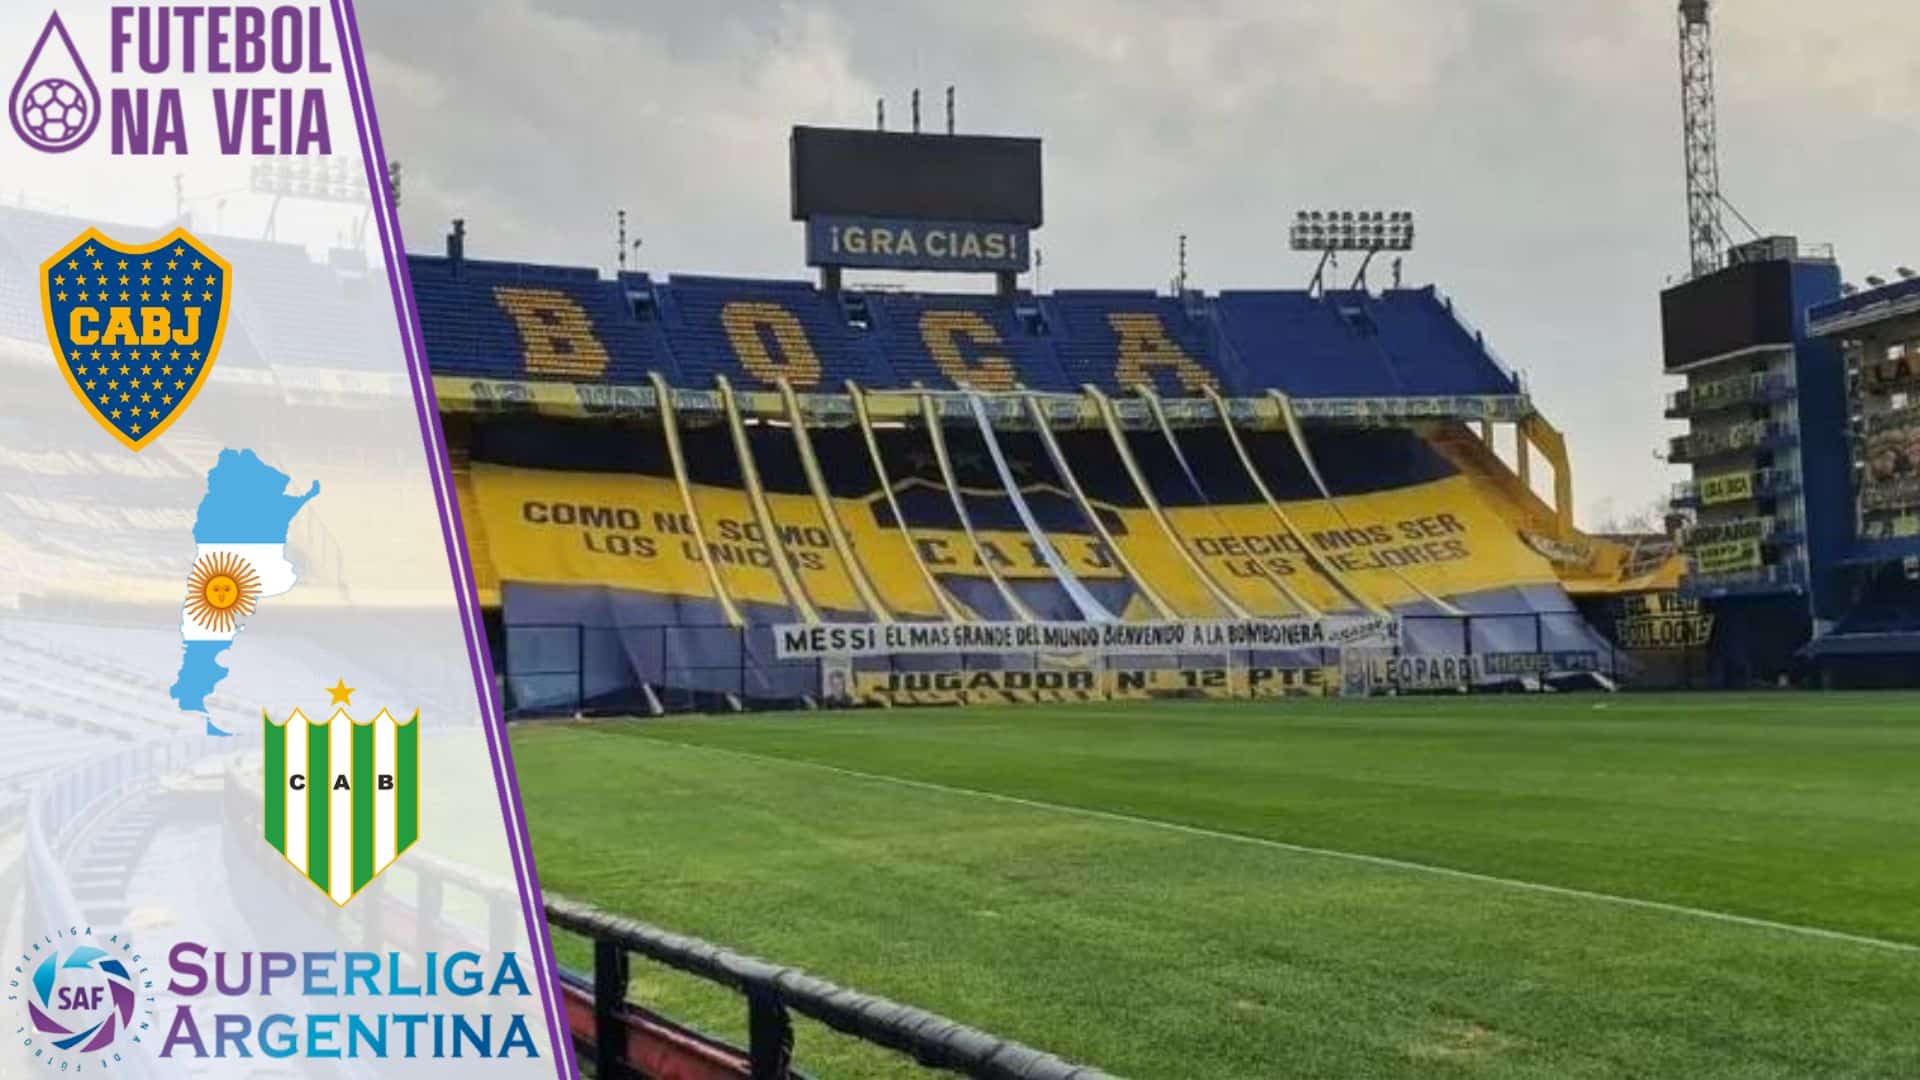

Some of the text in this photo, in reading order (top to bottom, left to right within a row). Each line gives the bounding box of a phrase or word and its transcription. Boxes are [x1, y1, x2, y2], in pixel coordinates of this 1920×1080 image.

[522, 501, 641, 530] COMO
[717, 518, 856, 550] SOMO
[1397, 512, 1466, 541] SER
[583, 532, 825, 572] LOS UNICS
[784, 628, 875, 651] MESSI
[885, 626, 906, 647] EL
[909, 625, 949, 648] MAS
[952, 624, 1011, 647] GRANDE
[1016, 623, 1041, 646] DEL
[1043, 624, 1099, 647] MUNDO
[1103, 622, 1185, 646] BIENVENIDO
[1192, 623, 1203, 645] A
[1206, 623, 1225, 645] LA
[1227, 621, 1324, 645] BOMBONERA
[871, 670, 1094, 691] JUGADOR
[1182, 669, 1228, 688] 12
[1248, 668, 1322, 688] PTE
